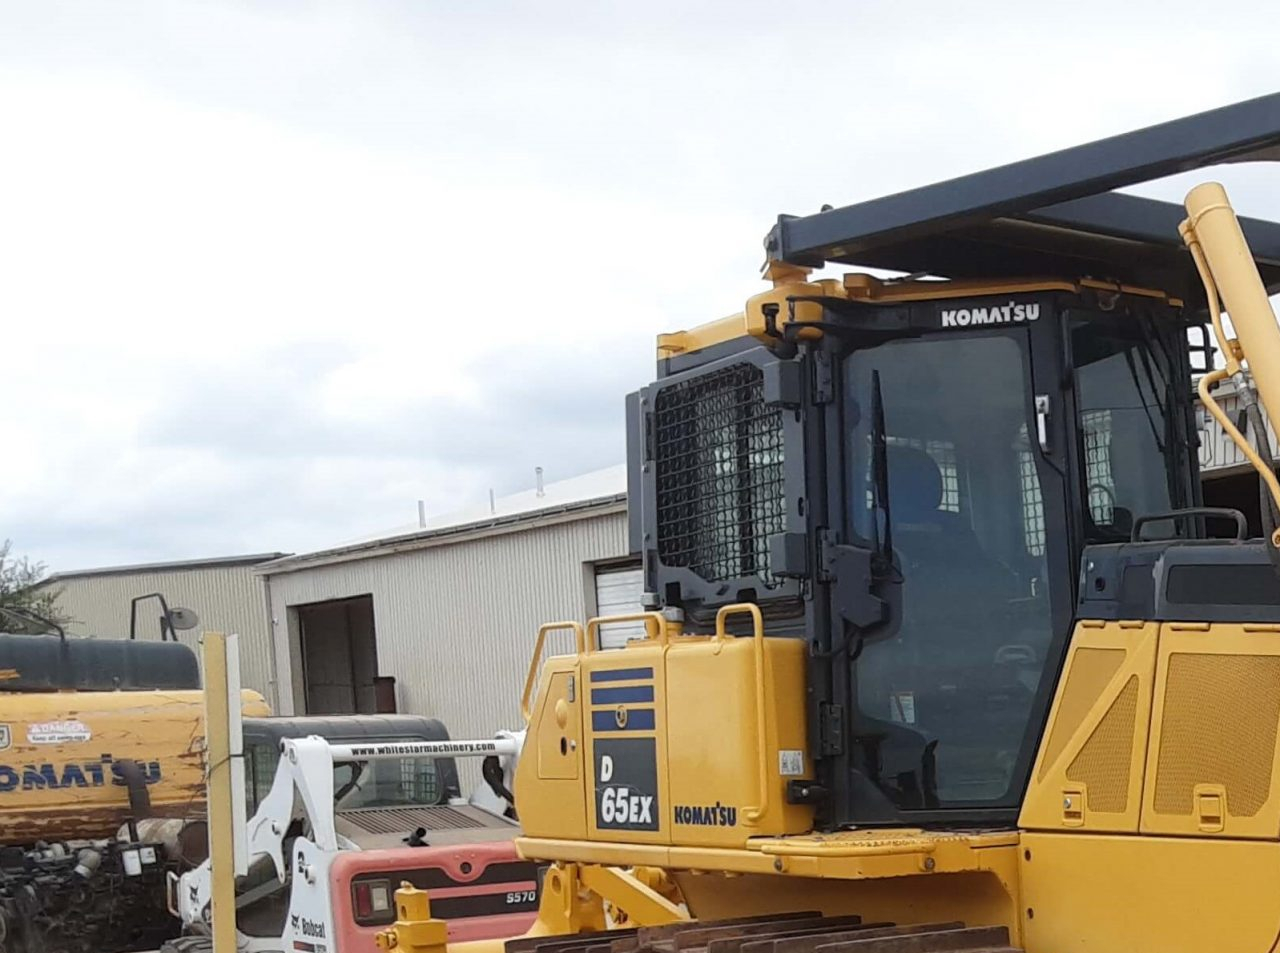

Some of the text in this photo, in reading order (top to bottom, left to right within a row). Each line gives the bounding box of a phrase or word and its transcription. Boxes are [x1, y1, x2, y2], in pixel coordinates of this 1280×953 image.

[942, 301, 1040, 327] KOMATSU
[352, 743, 496, 756] www.whitestarmachinery.com
[600, 755, 614, 782] D
[601, 787, 653, 824] 65EX
[674, 801, 737, 826] KOMATSU
[506, 891, 536, 904] S570
[301, 918, 326, 939] Bobcat
